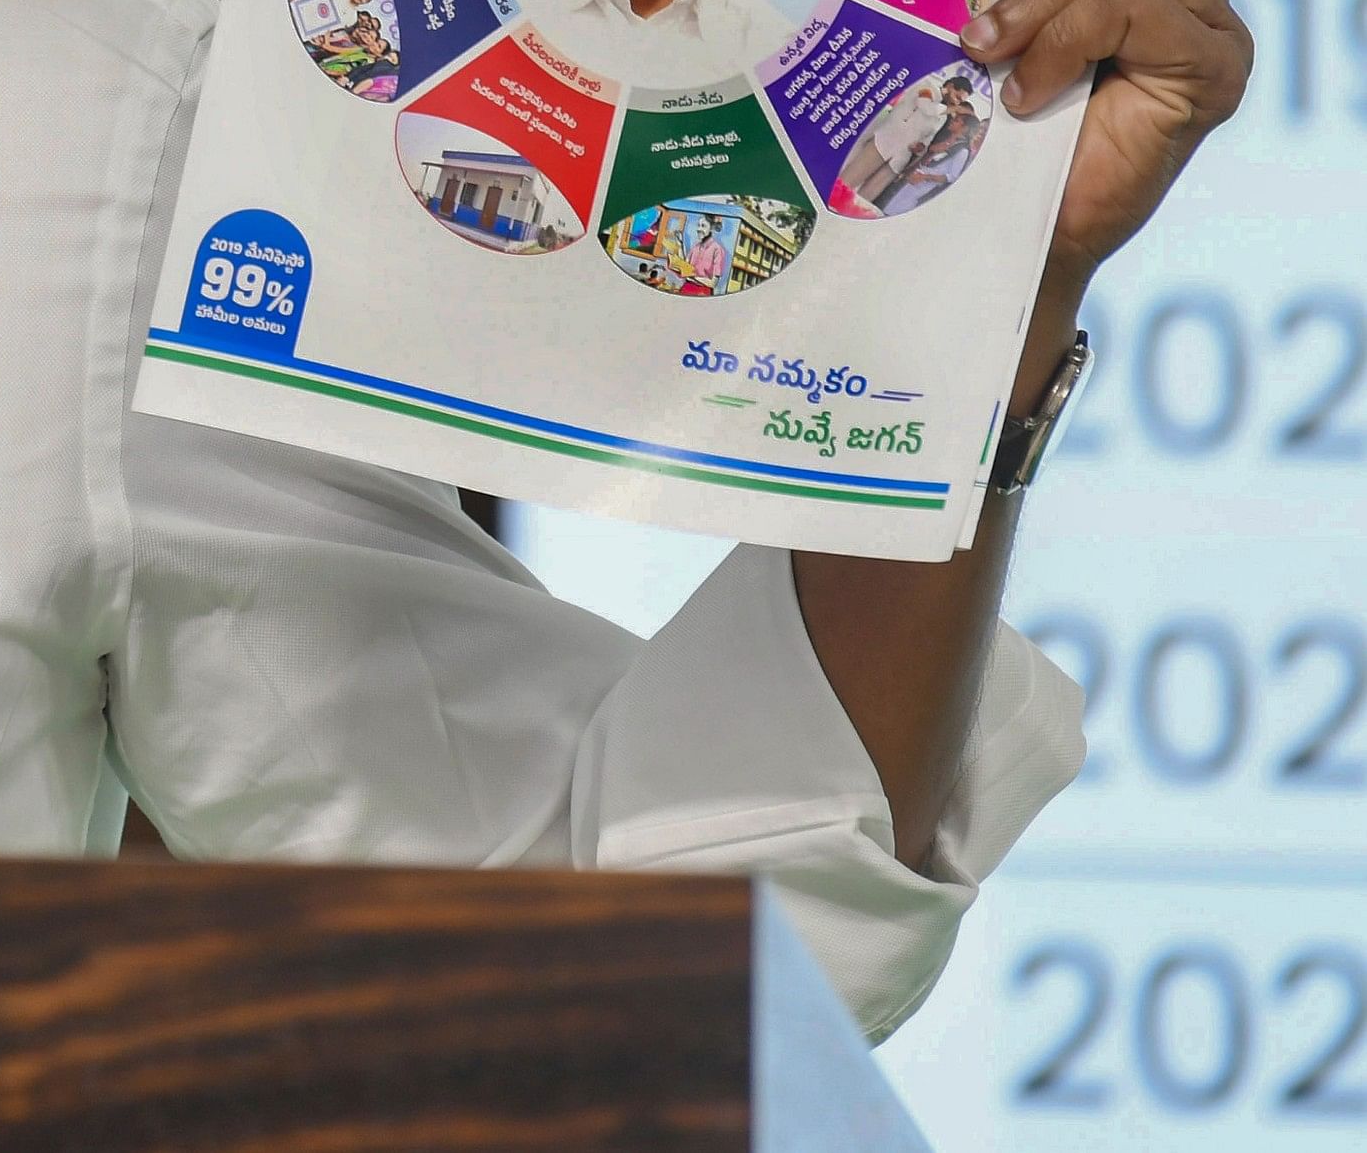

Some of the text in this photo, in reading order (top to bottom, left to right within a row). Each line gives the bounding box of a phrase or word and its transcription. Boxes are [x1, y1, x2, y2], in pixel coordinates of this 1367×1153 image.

[779, 18, 831, 66] ఉన్నత విద్య
[522, 32, 602, 95] పేదలందరికీ ఇళ్లు
[662, 92, 724, 110] నాడు-నేడు
[784, 69, 818, 99] జగనన్న
[809, 93, 842, 123] జగనన్న
[650, 133, 704, 153] నాడు-నేడు
[209, 237, 305, 275] 2019 మేనిఫెస్టో
[200, 257, 294, 316] 99%
[195, 304, 287, 335] హామీల అమలు
[682, 340, 868, 404] మా నమ్మకం
[763, 410, 926, 458] నువ్వే జగన్
